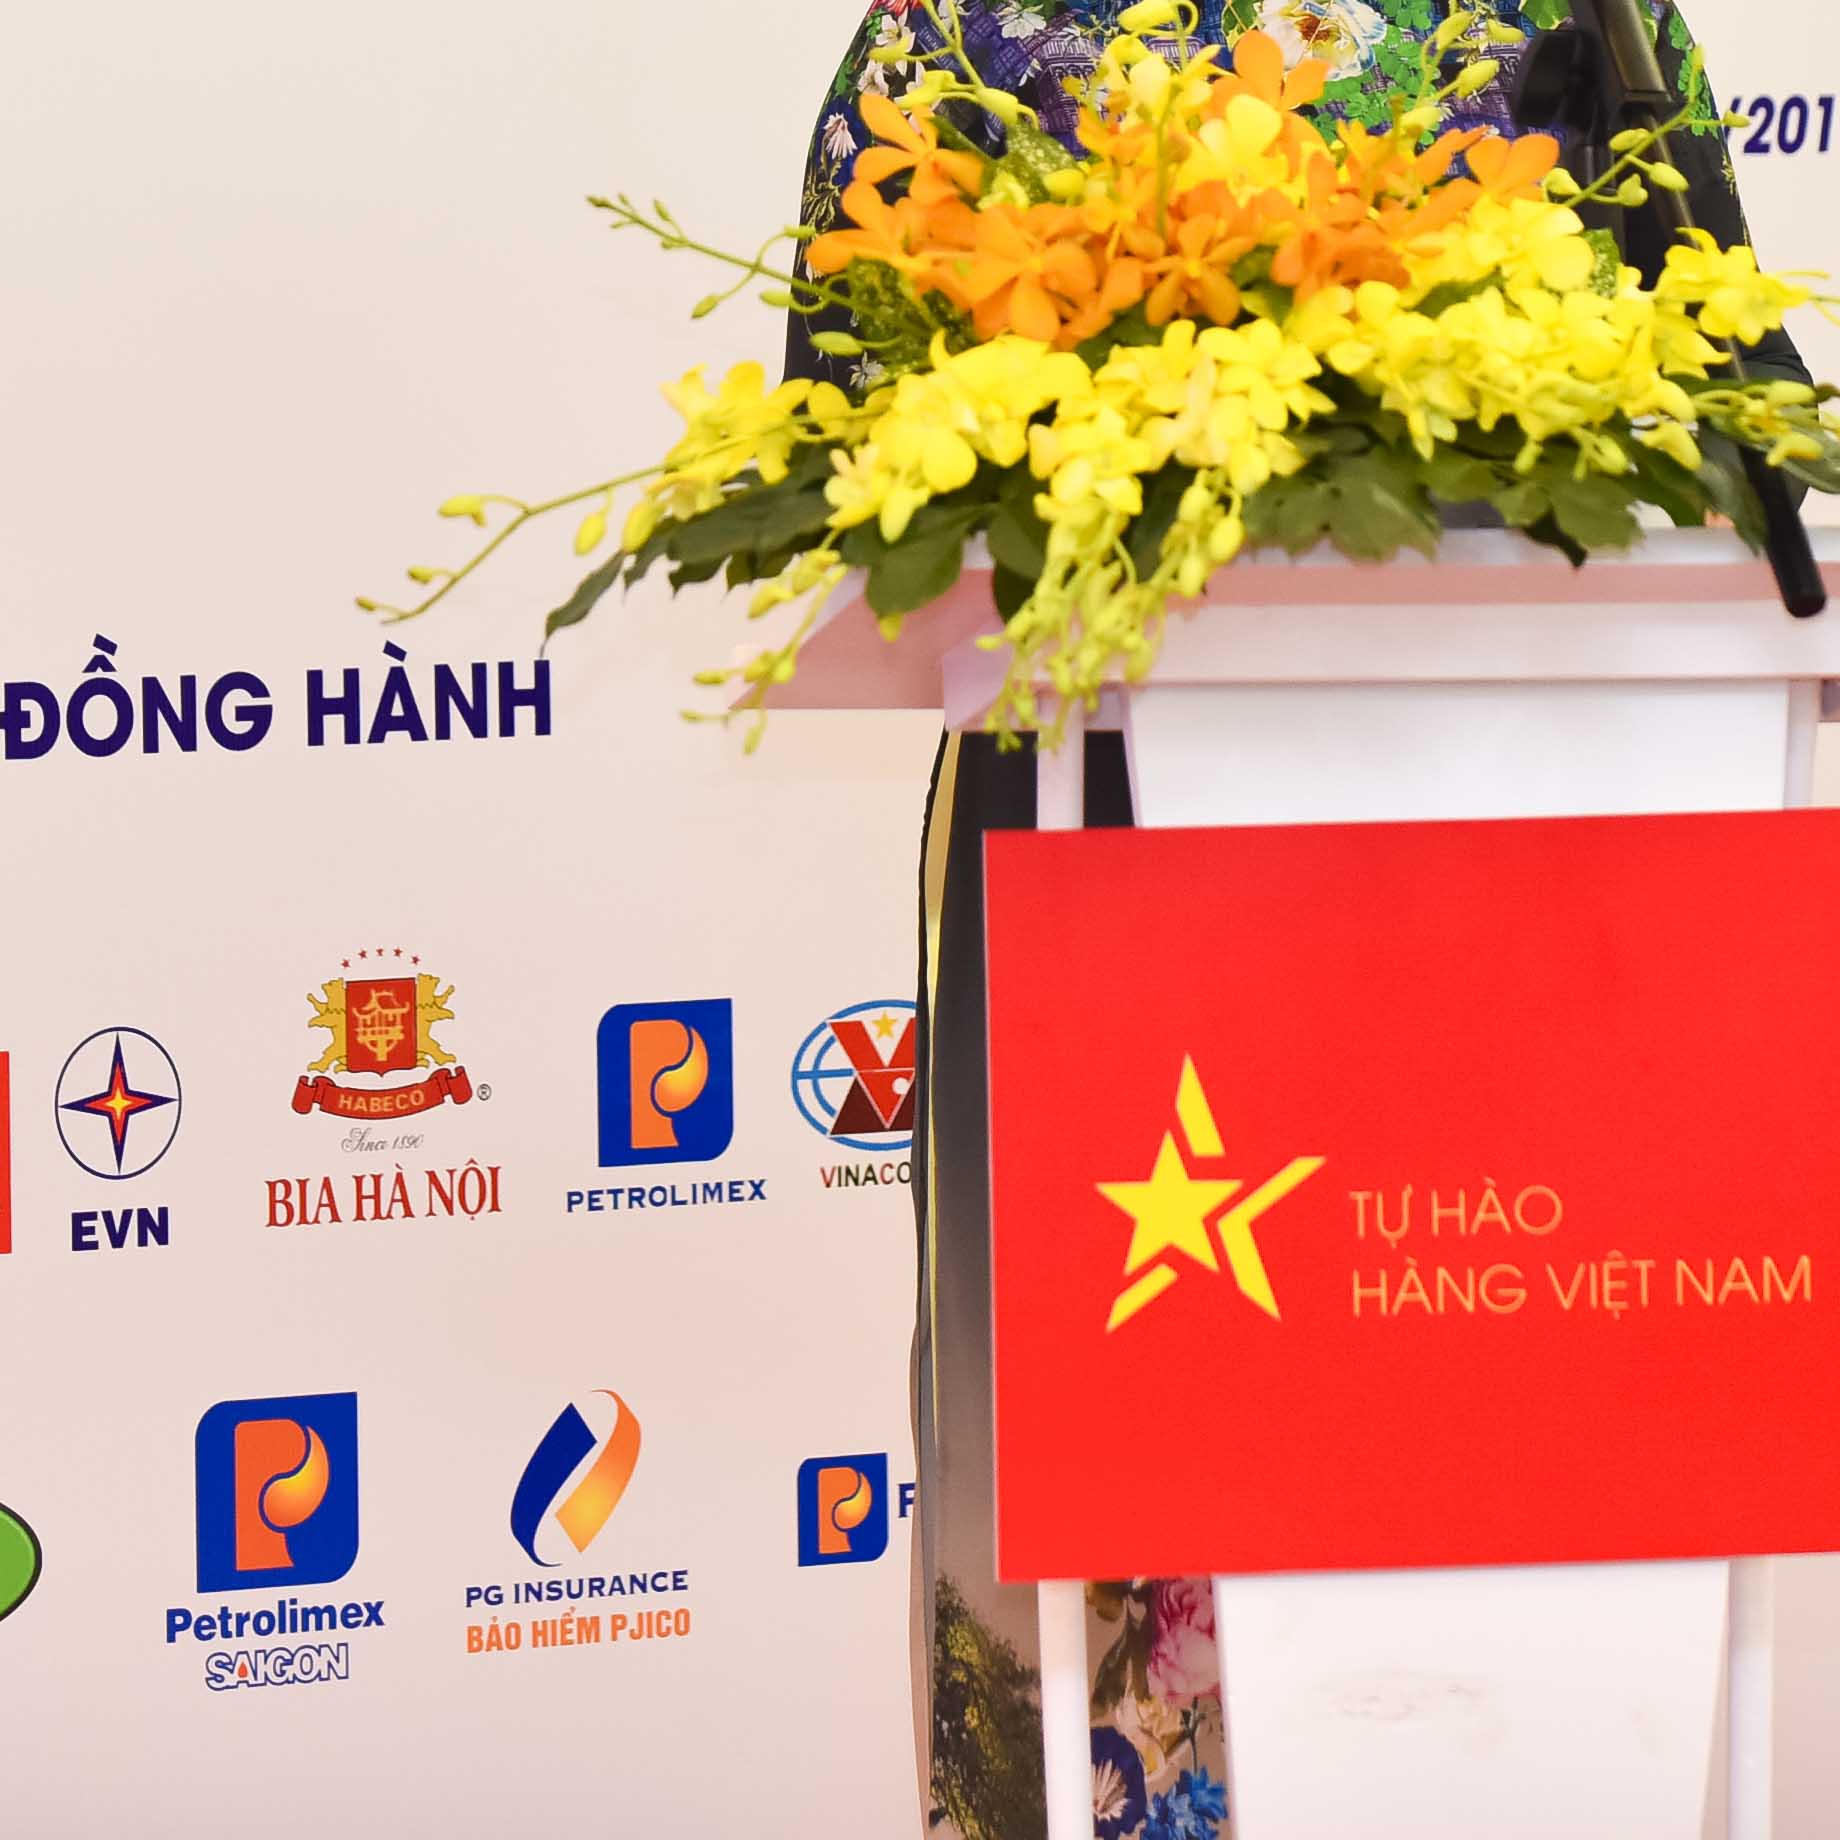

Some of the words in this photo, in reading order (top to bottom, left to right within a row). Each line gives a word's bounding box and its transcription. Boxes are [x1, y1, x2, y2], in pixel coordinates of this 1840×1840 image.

[0, 634, 273, 760] ĐỒNG
[307, 641, 551, 746] HÀNH
[338, 1090, 425, 1112] HABECO
[265, 1177, 342, 1227] BIA
[352, 1163, 415, 1221] HÀ
[425, 1158, 501, 1220] NỘI
[567, 1179, 766, 1212] PETROLIMEX
[1350, 1184, 1412, 1248] TỰ
[1431, 1177, 1562, 1235] HÀO
[72, 1207, 168, 1251] EVN
[1353, 1257, 1526, 1316] HÀNG
[1546, 1250, 1654, 1318] VIỆT
[1676, 1255, 1811, 1305] NAM
[466, 1586, 503, 1608] PG
[515, 1570, 688, 1603] INSURANCE
[167, 1598, 384, 1643] Petrolimex
[467, 1616, 521, 1653] BẢO
[532, 1607, 600, 1648] HIỂM
[611, 1608, 690, 1641] PJICO
[205, 1643, 349, 1691] SAIGON
